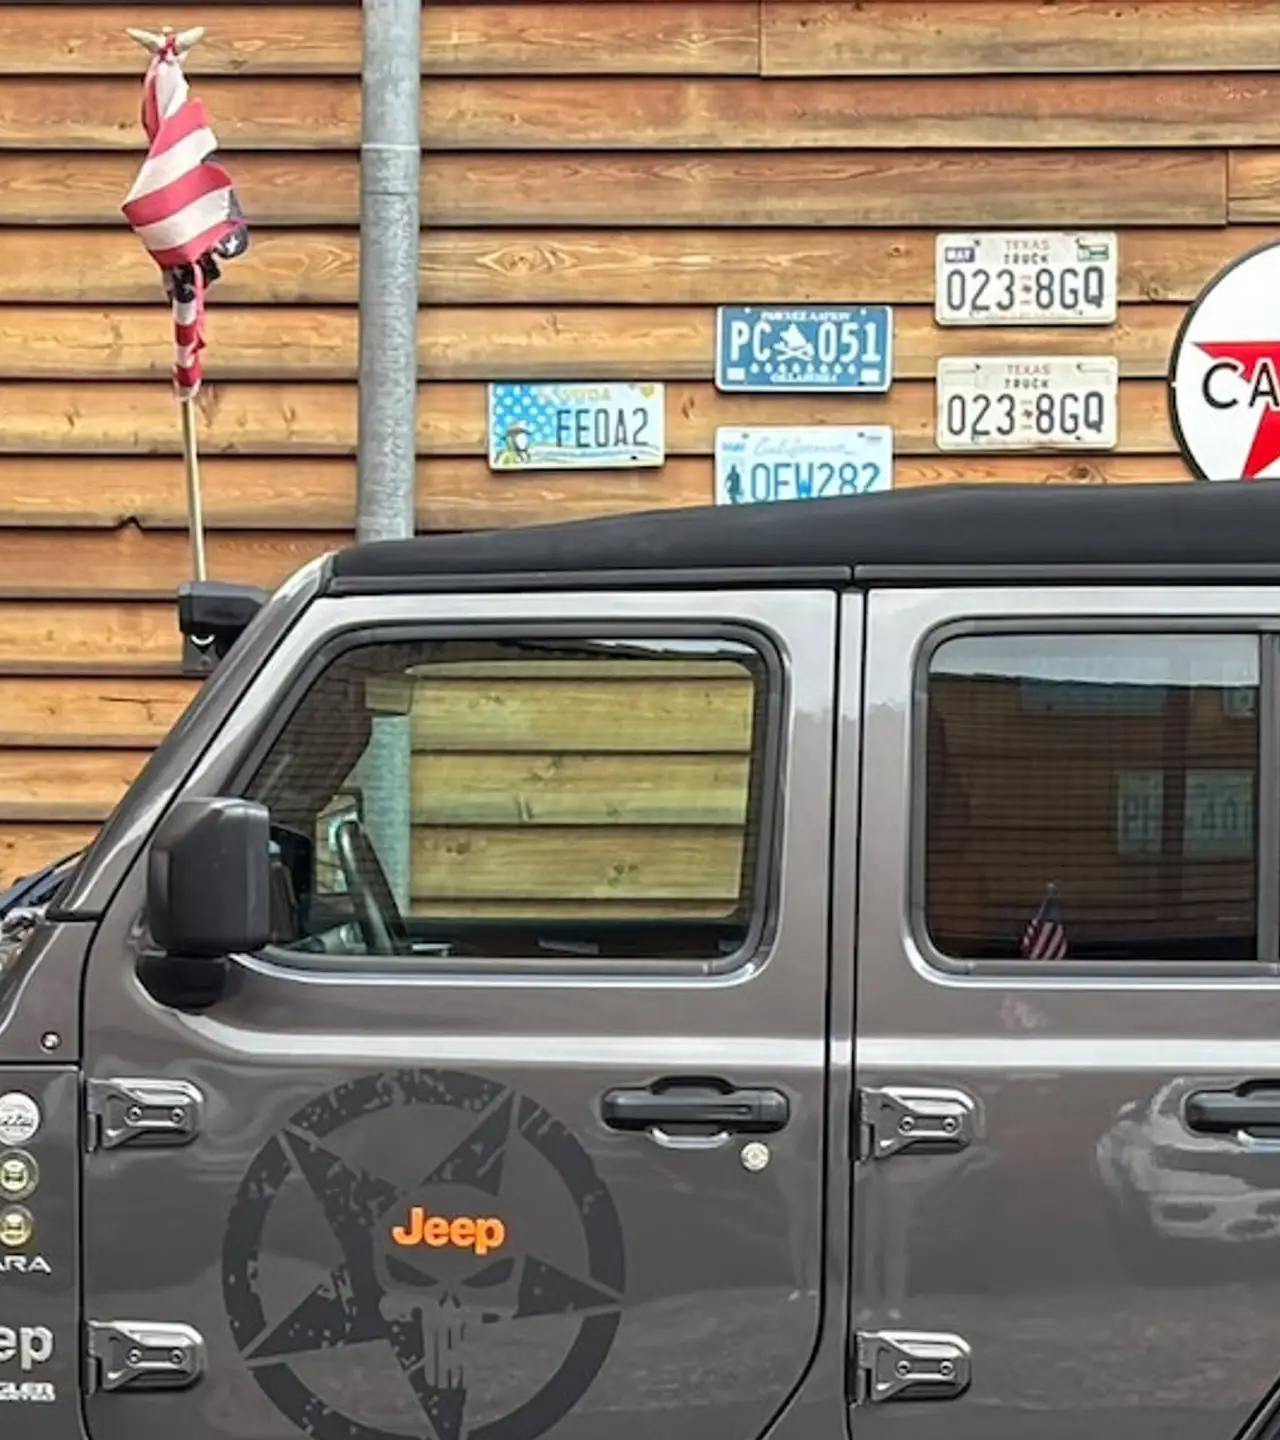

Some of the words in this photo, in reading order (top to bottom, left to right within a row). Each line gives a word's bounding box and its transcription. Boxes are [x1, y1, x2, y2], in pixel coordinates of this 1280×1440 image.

[1004, 254, 1050, 265] TRUCK
[730, 320, 772, 362] PC
[817, 321, 881, 363] 051
[1006, 364, 1051, 375] TEXAS
[1004, 379, 1049, 390] TRUCK
[391, 1206, 506, 1256] Jeep
